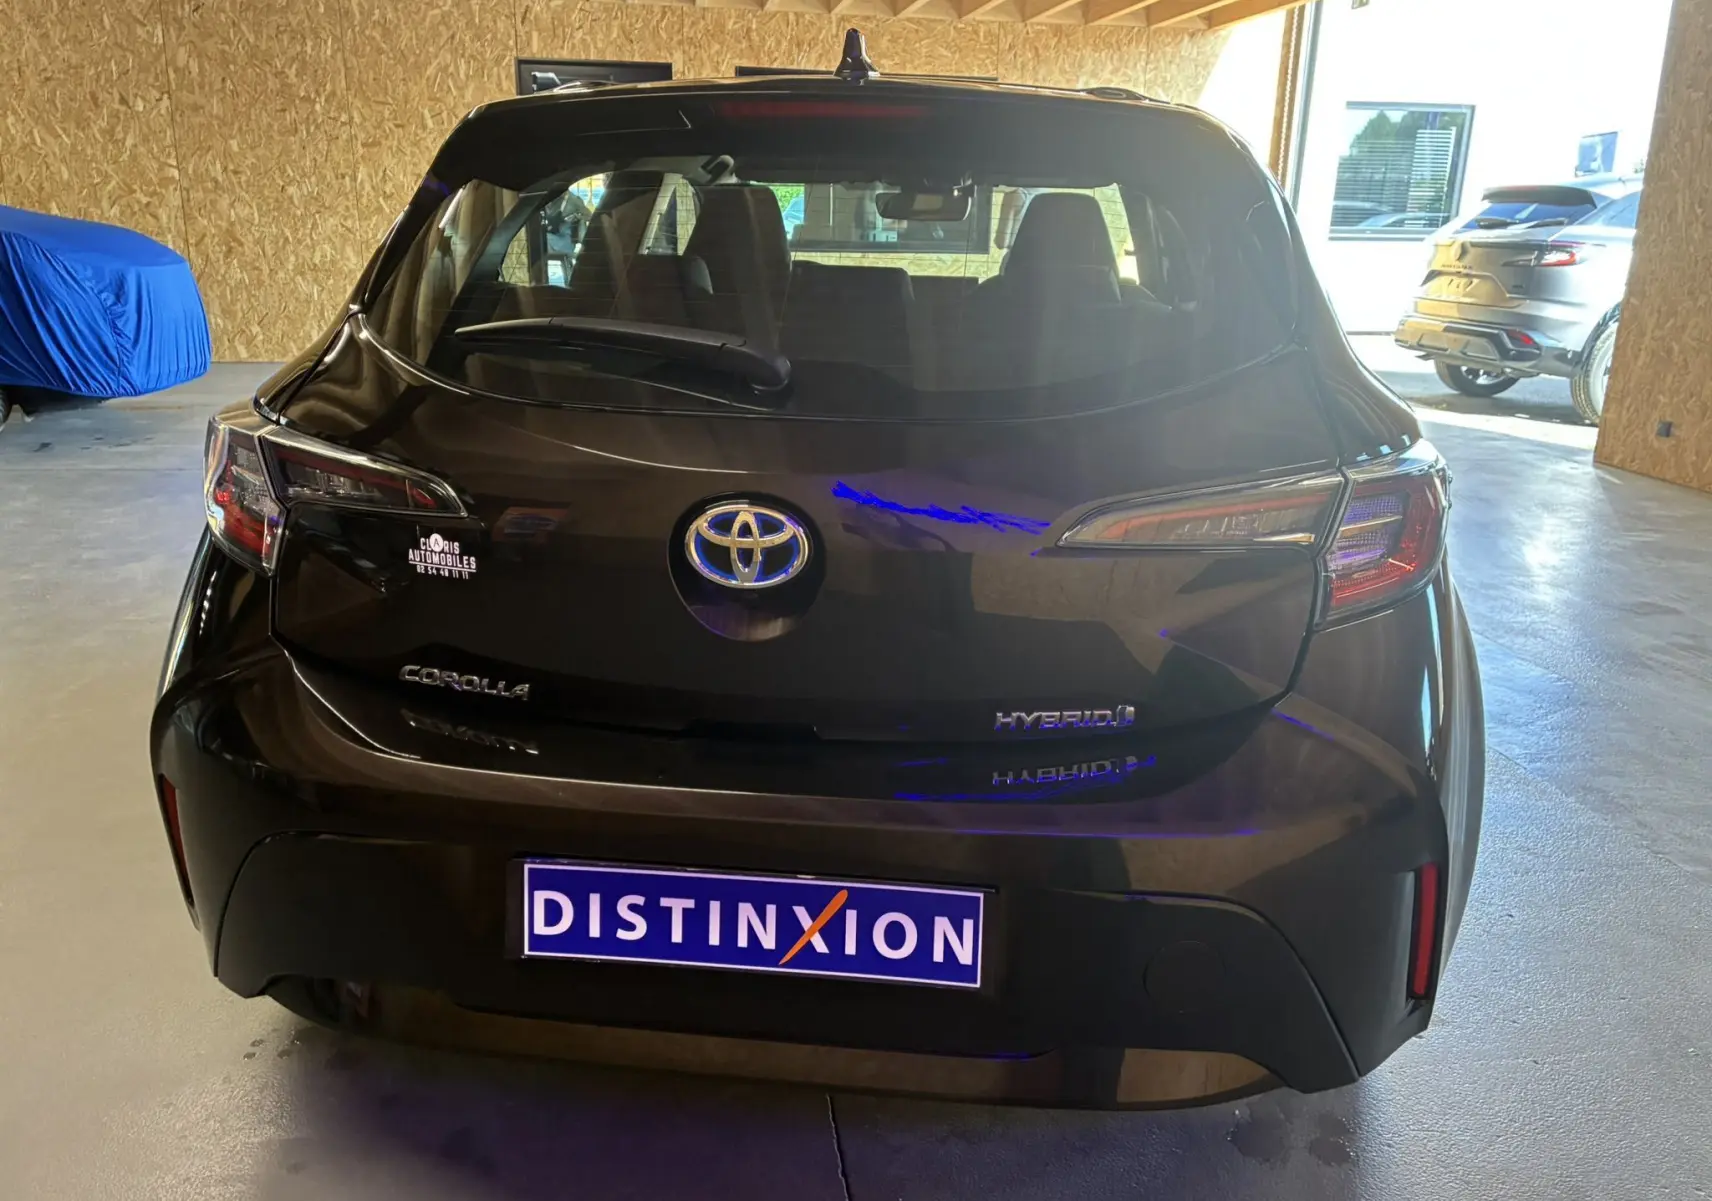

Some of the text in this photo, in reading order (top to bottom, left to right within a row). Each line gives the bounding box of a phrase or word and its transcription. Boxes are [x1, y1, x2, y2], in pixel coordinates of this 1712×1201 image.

[420, 533, 460, 554] CLARIS
[408, 548, 477, 569] AUTOMOBILES
[427, 566, 437, 575] 54
[399, 664, 530, 701] COROLLA
[994, 710, 1114, 731] HYBRID
[532, 889, 975, 966] DISTINXION
